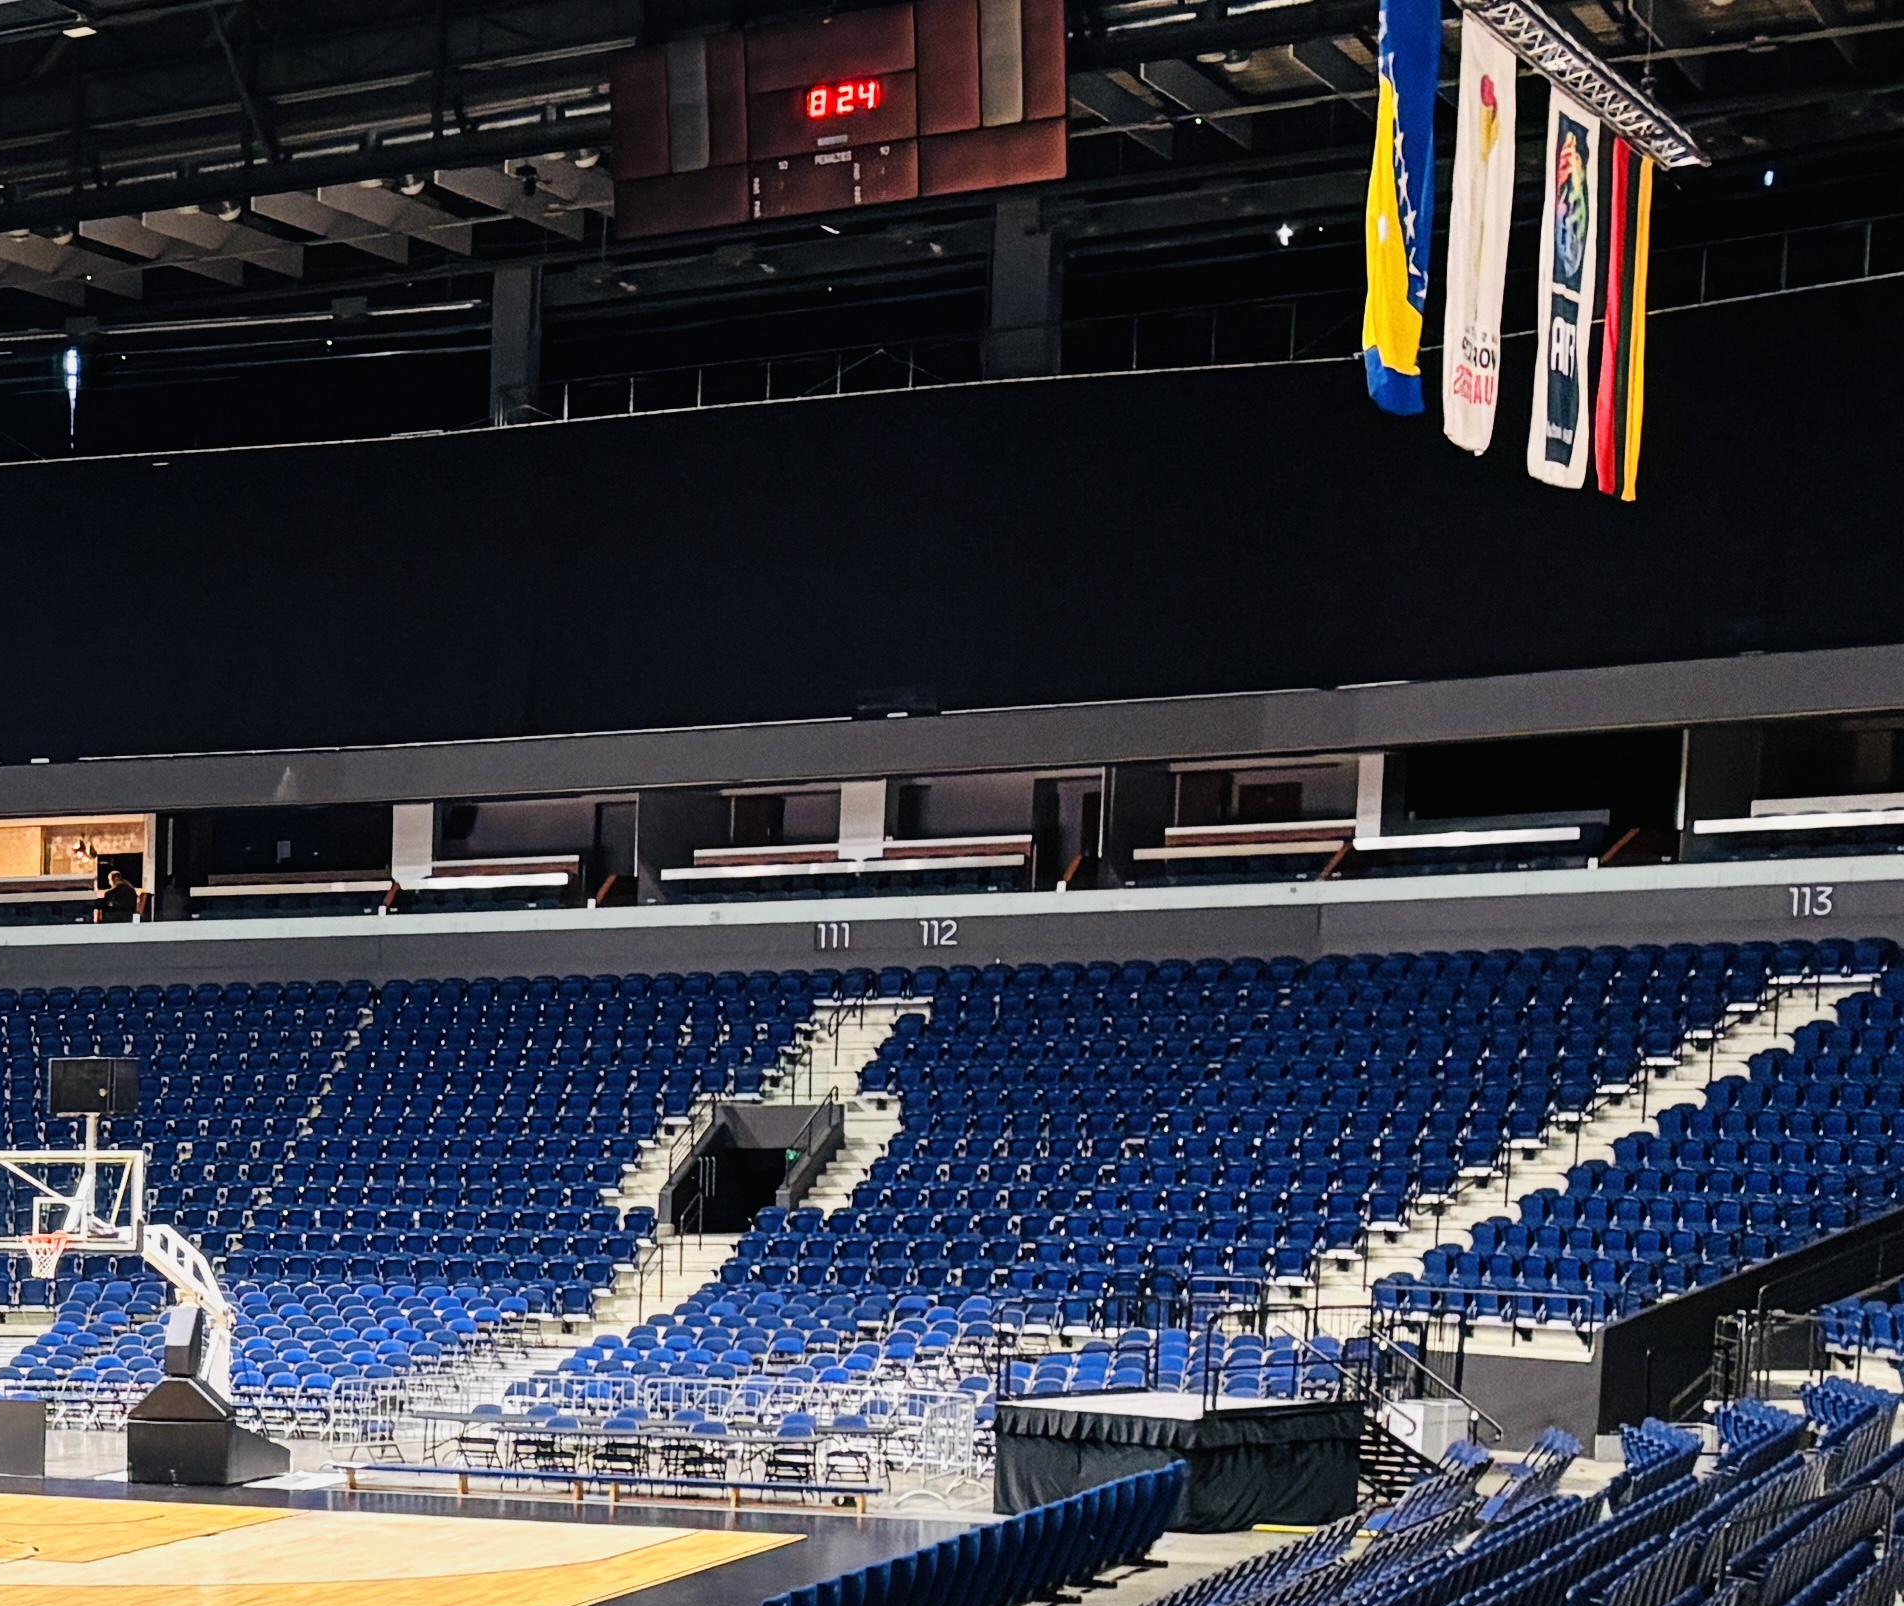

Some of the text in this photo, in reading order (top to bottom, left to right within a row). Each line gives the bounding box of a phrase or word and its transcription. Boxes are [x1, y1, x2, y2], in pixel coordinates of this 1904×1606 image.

[1790, 887, 1833, 916] 113
[817, 922, 850, 948] 111
[920, 920, 957, 945] 112
